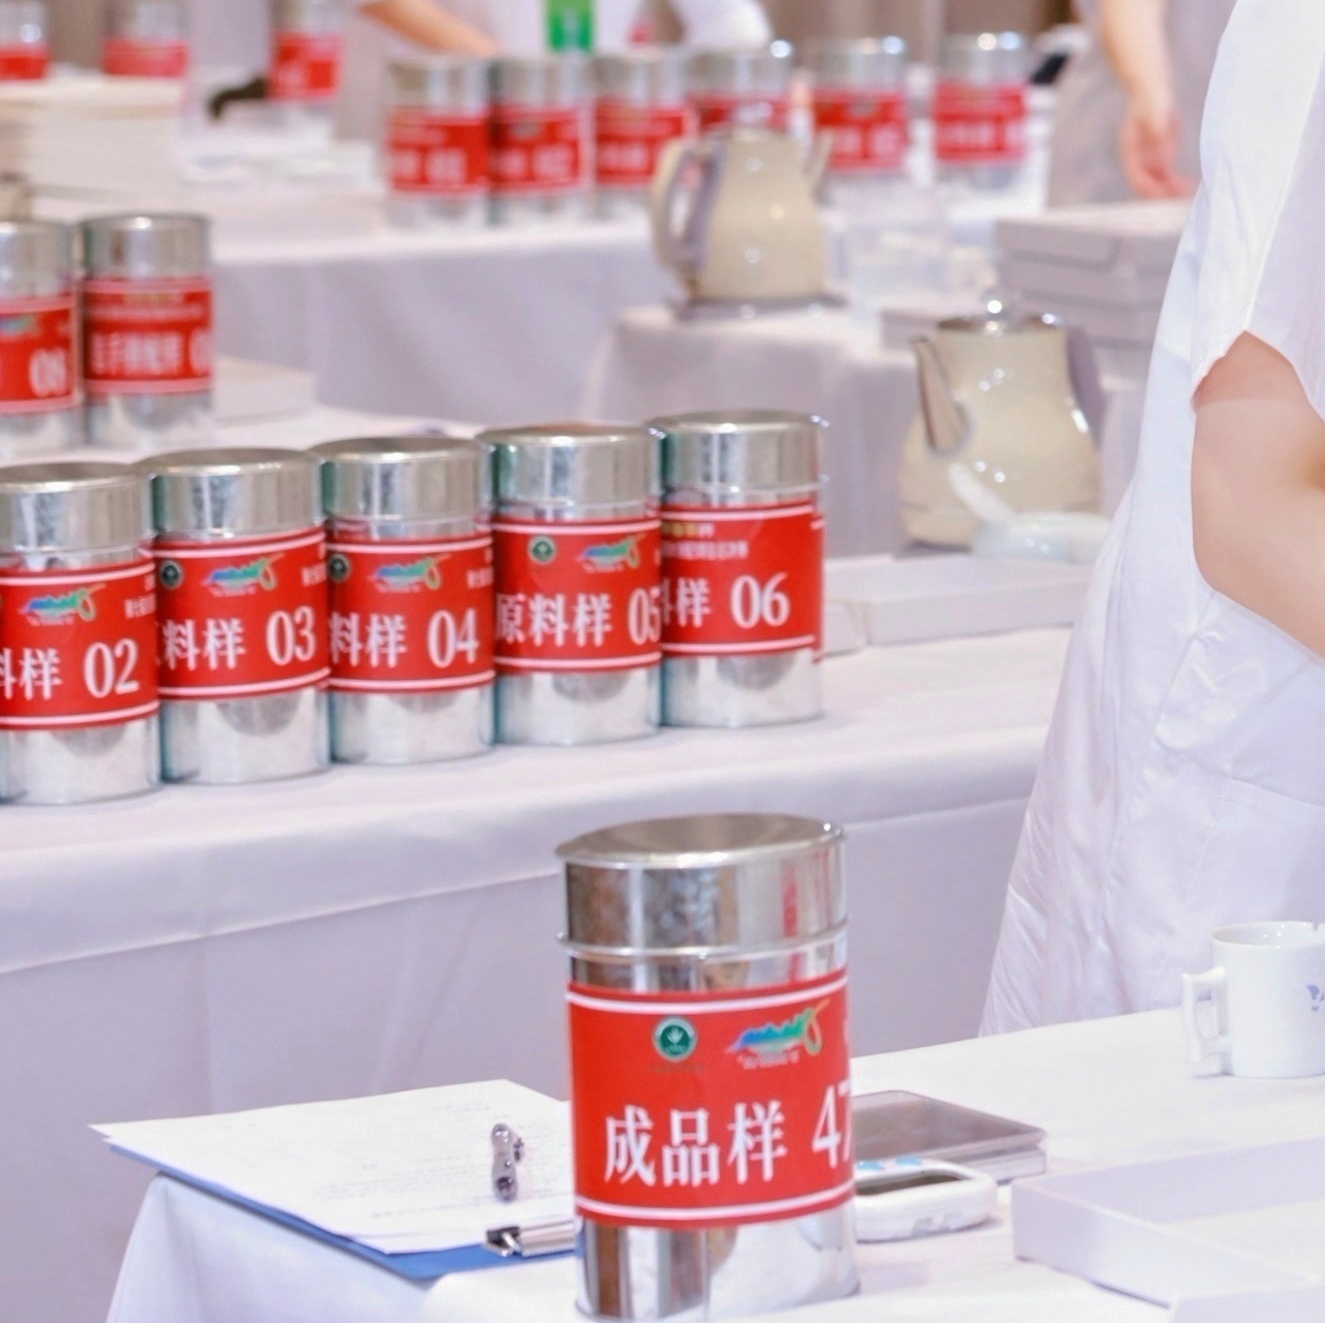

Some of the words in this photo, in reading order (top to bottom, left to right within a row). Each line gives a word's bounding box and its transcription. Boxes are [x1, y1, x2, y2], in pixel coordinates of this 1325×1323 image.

[496, 592, 612, 647] 原料样
[730, 572, 790, 629] 06
[265, 606, 316, 667] 03
[427, 607, 479, 669] 04
[83, 638, 140, 699] 02
[604, 1099, 788, 1188] 成品样
